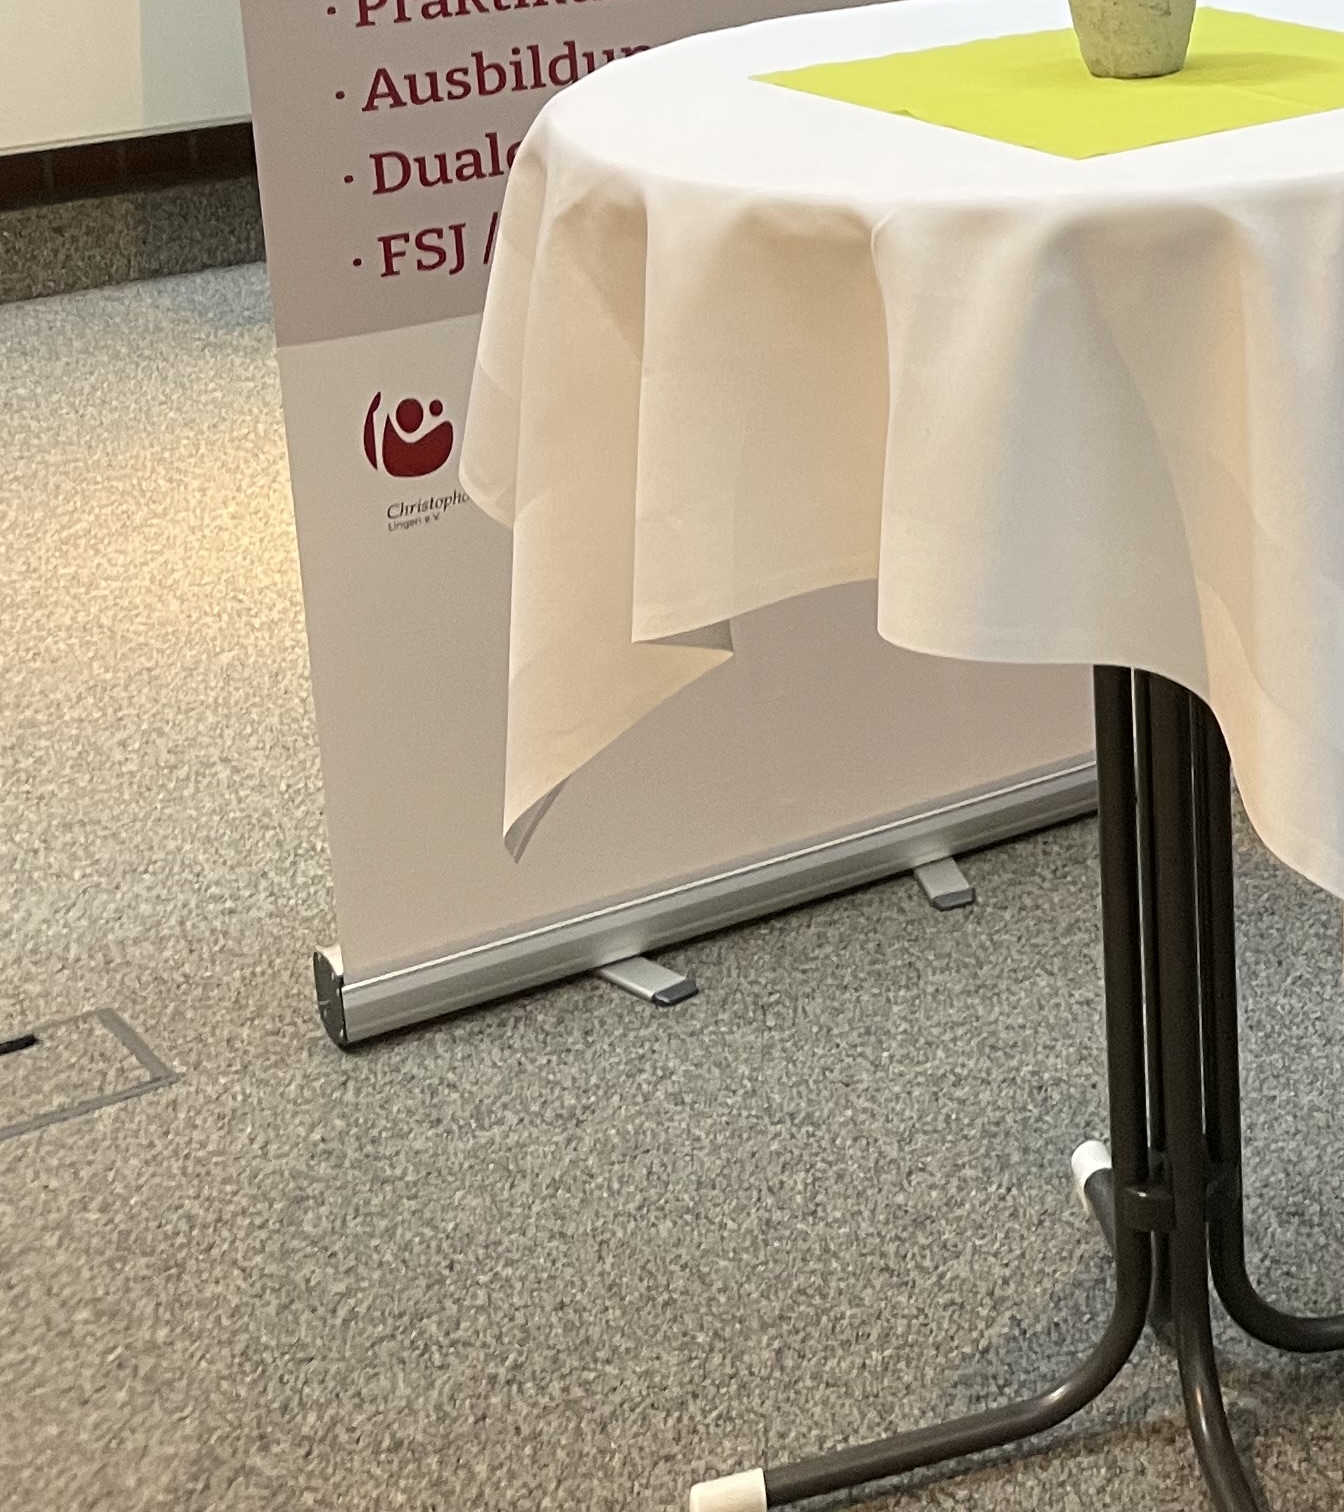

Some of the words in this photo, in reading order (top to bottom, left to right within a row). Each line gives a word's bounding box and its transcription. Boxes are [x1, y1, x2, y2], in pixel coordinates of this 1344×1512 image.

[361, 39, 652, 112] Ausbildu
[377, 223, 466, 277] FSJ
[387, 489, 470, 520] Christopho
